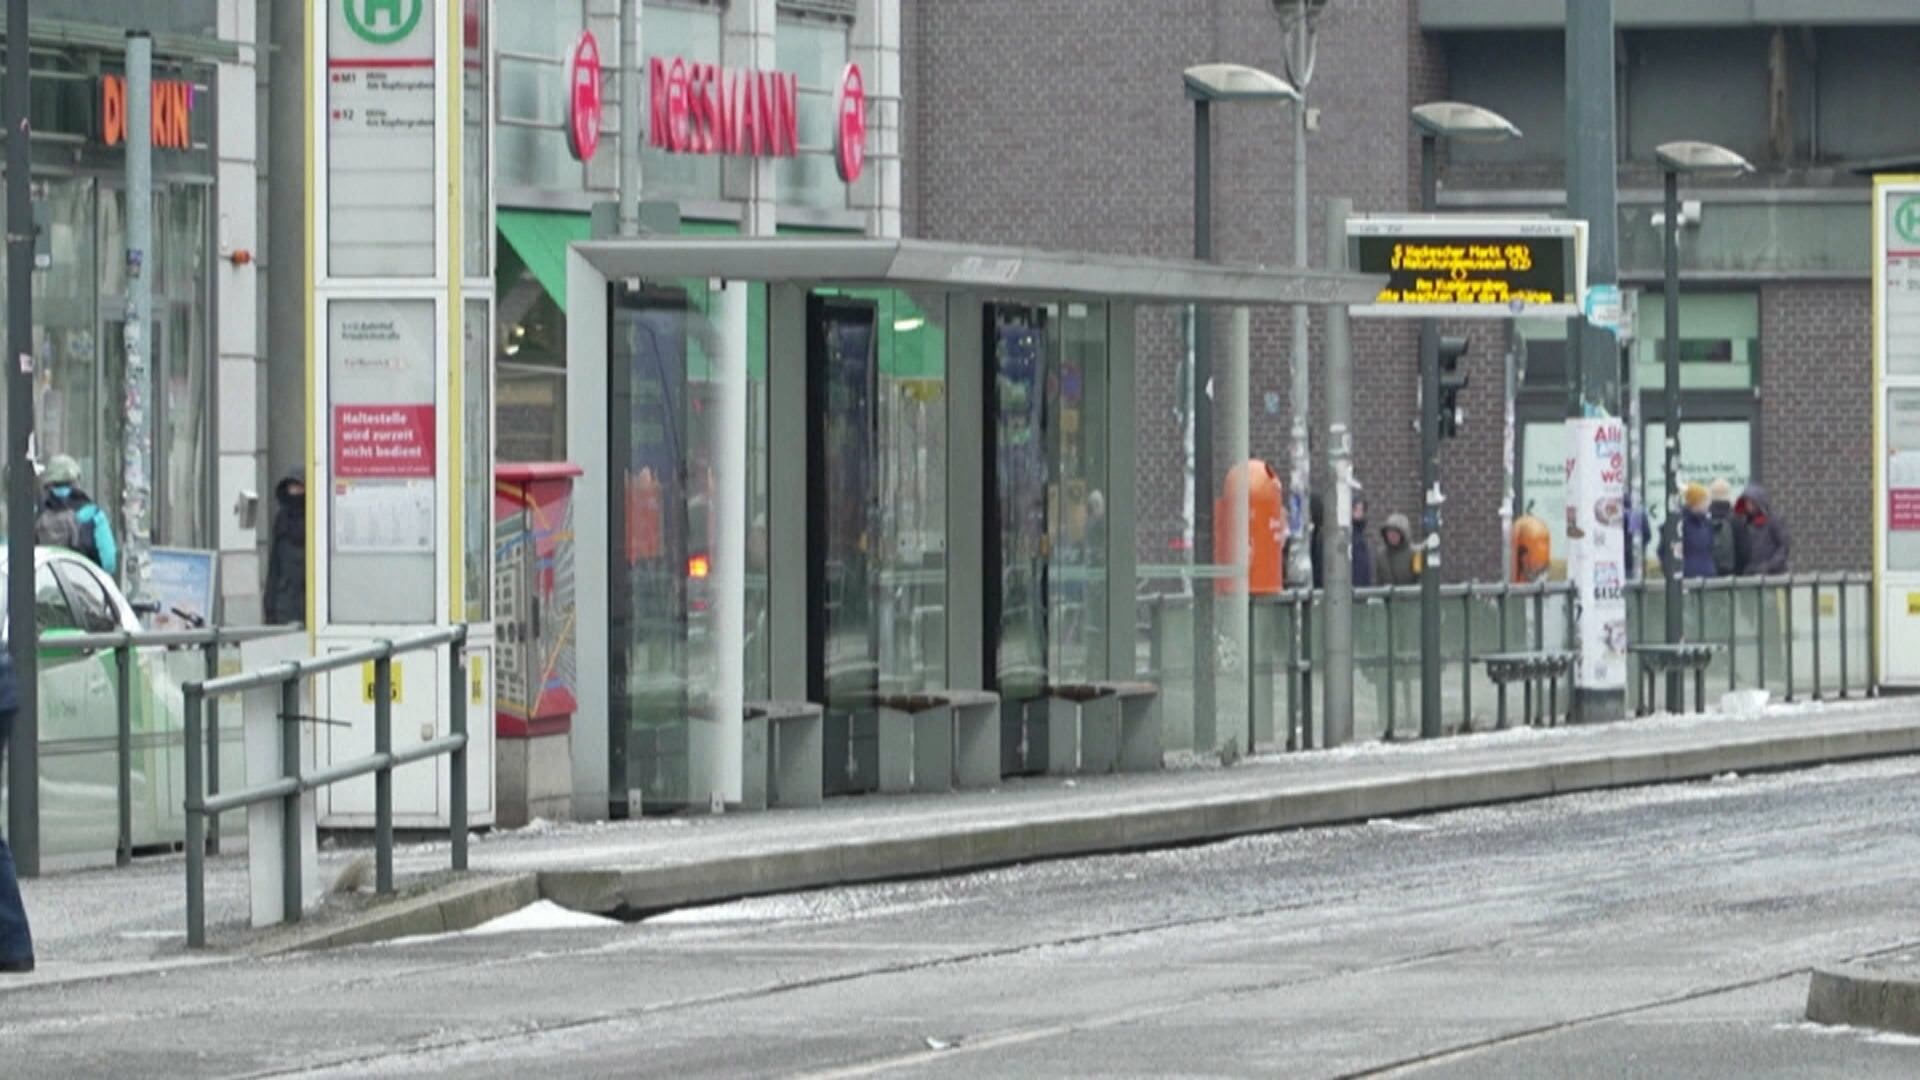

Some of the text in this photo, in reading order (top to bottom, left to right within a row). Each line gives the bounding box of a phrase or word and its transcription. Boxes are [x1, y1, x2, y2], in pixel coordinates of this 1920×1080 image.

[650, 56, 798, 157] ROSSMANN
[1406, 244, 1464, 258] Hackescher
[1469, 244, 1500, 258] Markt
[343, 412, 407, 425] Haltestelle
[342, 430, 414, 442] wird zurzeit
[342, 445, 422, 458] nicht bedient
